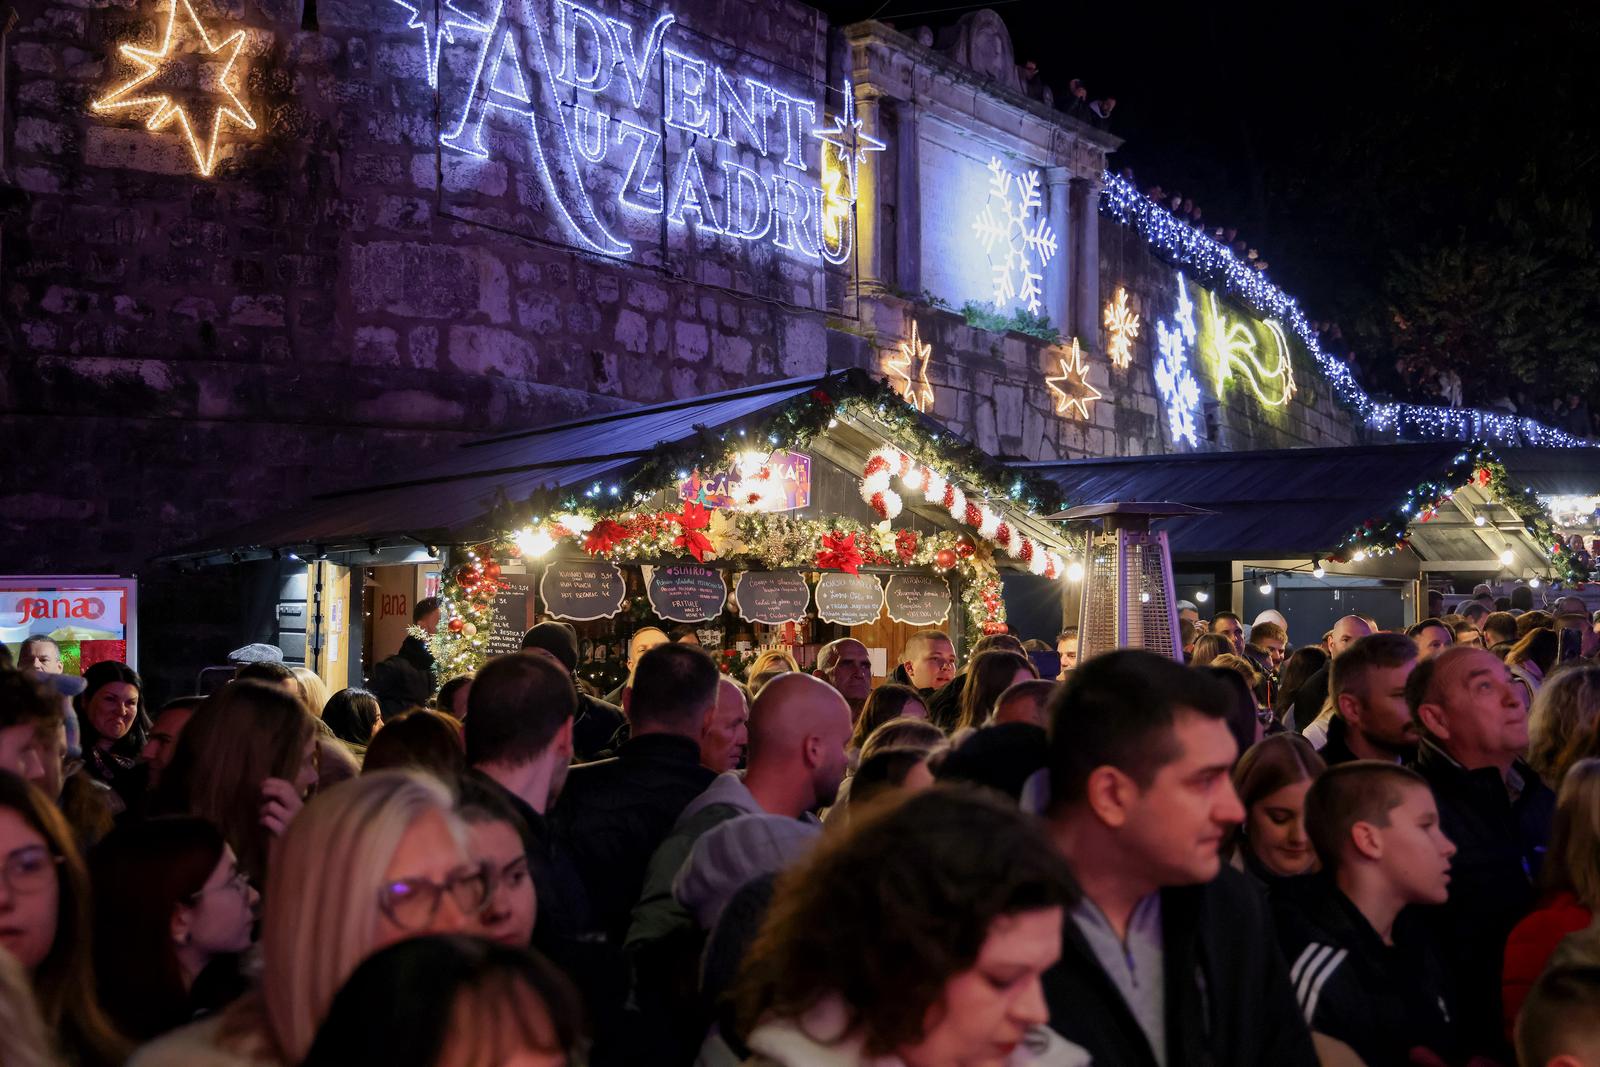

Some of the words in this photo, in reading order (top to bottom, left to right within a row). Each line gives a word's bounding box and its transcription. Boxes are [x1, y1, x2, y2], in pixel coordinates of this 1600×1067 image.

[440, 0, 816, 254] ADVENT
[575, 104, 611, 163] U
[618, 120, 855, 264] ZADRU
